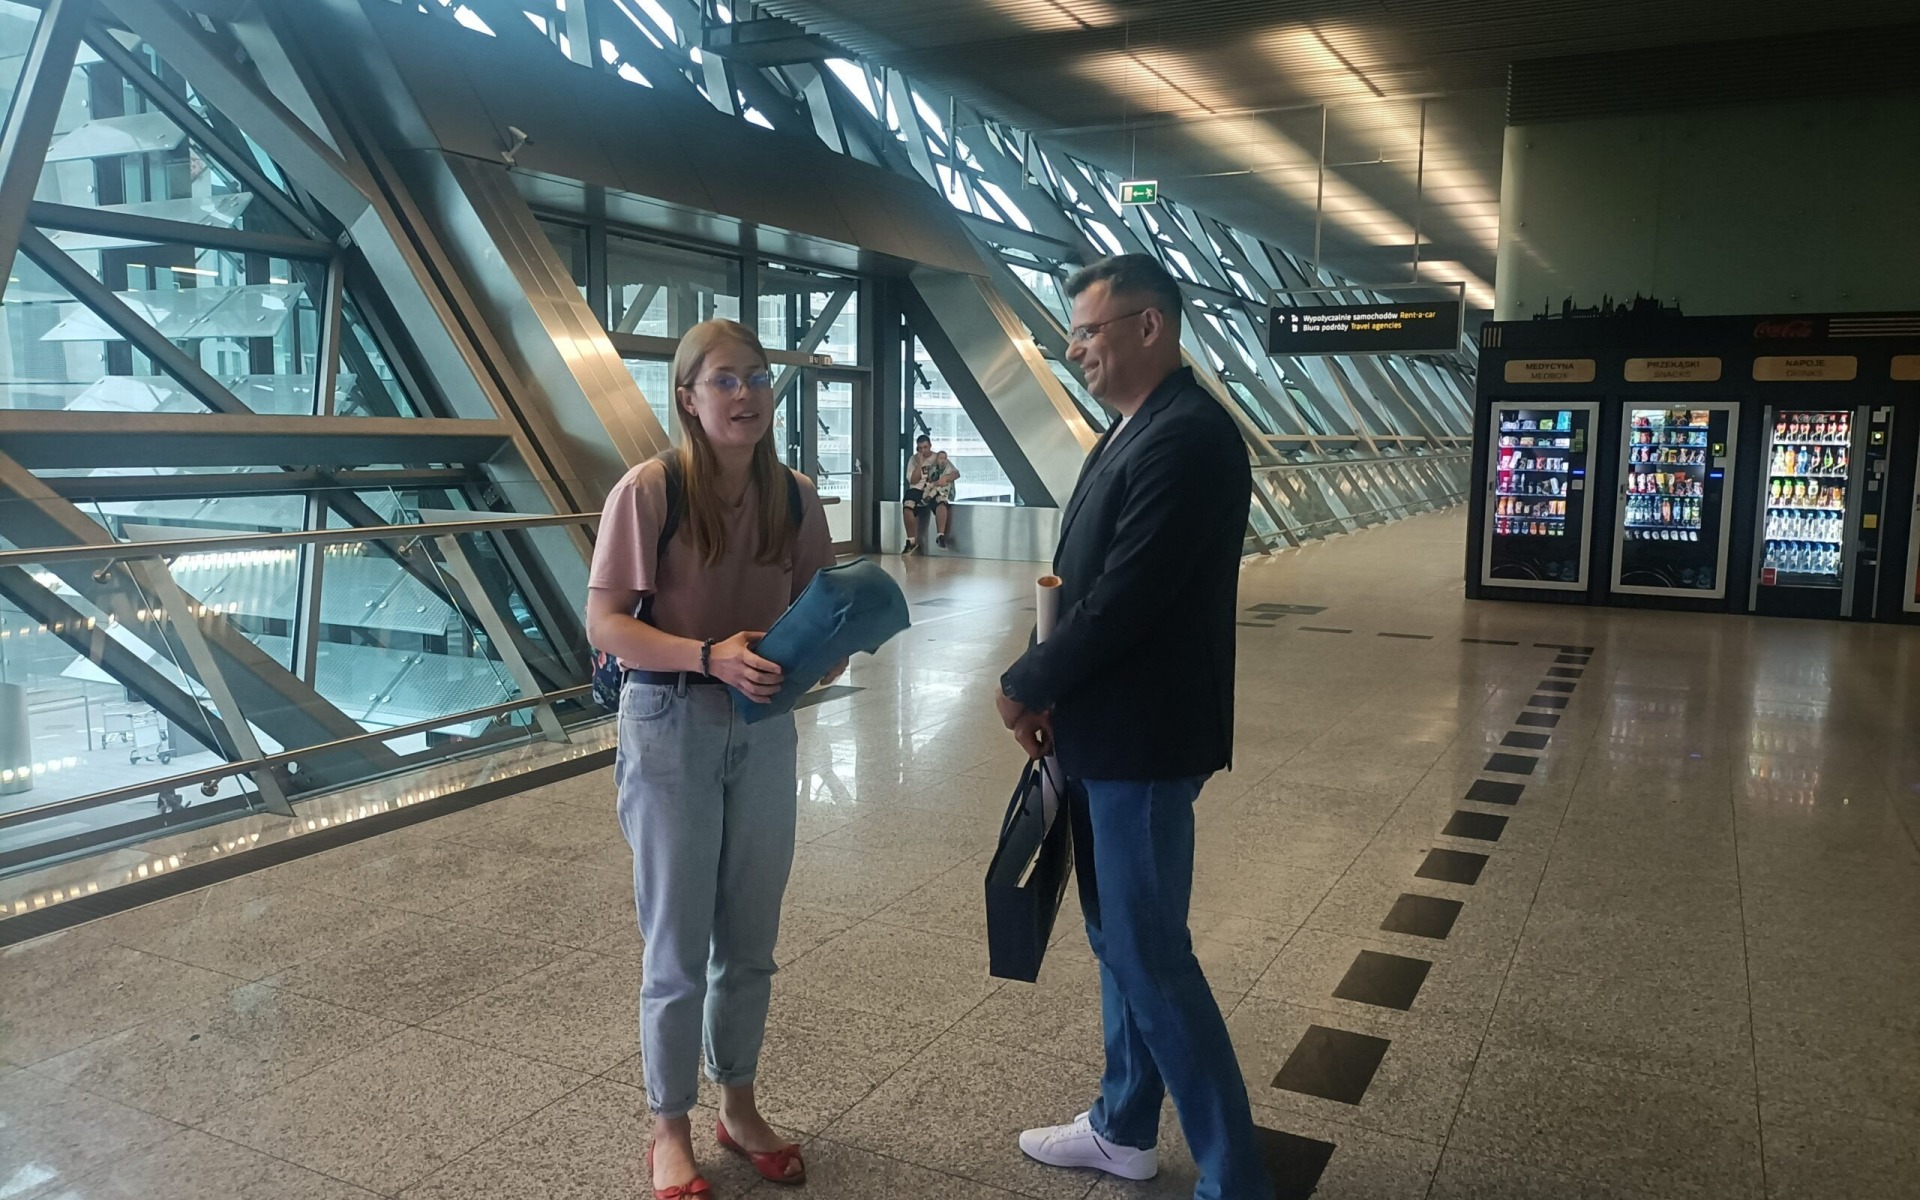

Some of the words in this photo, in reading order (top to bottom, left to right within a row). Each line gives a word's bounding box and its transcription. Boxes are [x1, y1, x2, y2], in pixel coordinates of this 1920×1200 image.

[1303, 313, 1351, 323] Wypożyczalnie
[1353, 312, 1398, 320] samochodów
[1400, 311, 1436, 319] Rent-a-car
[1303, 324, 1320, 332] Biura
[1321, 323, 1348, 333] podróży
[1351, 322, 1370, 330] Travel
[1372, 322, 1402, 331] agencies
[1647, 361, 1700, 369] PRZEKĄSKI
[1785, 359, 1825, 367] NAPOJE
